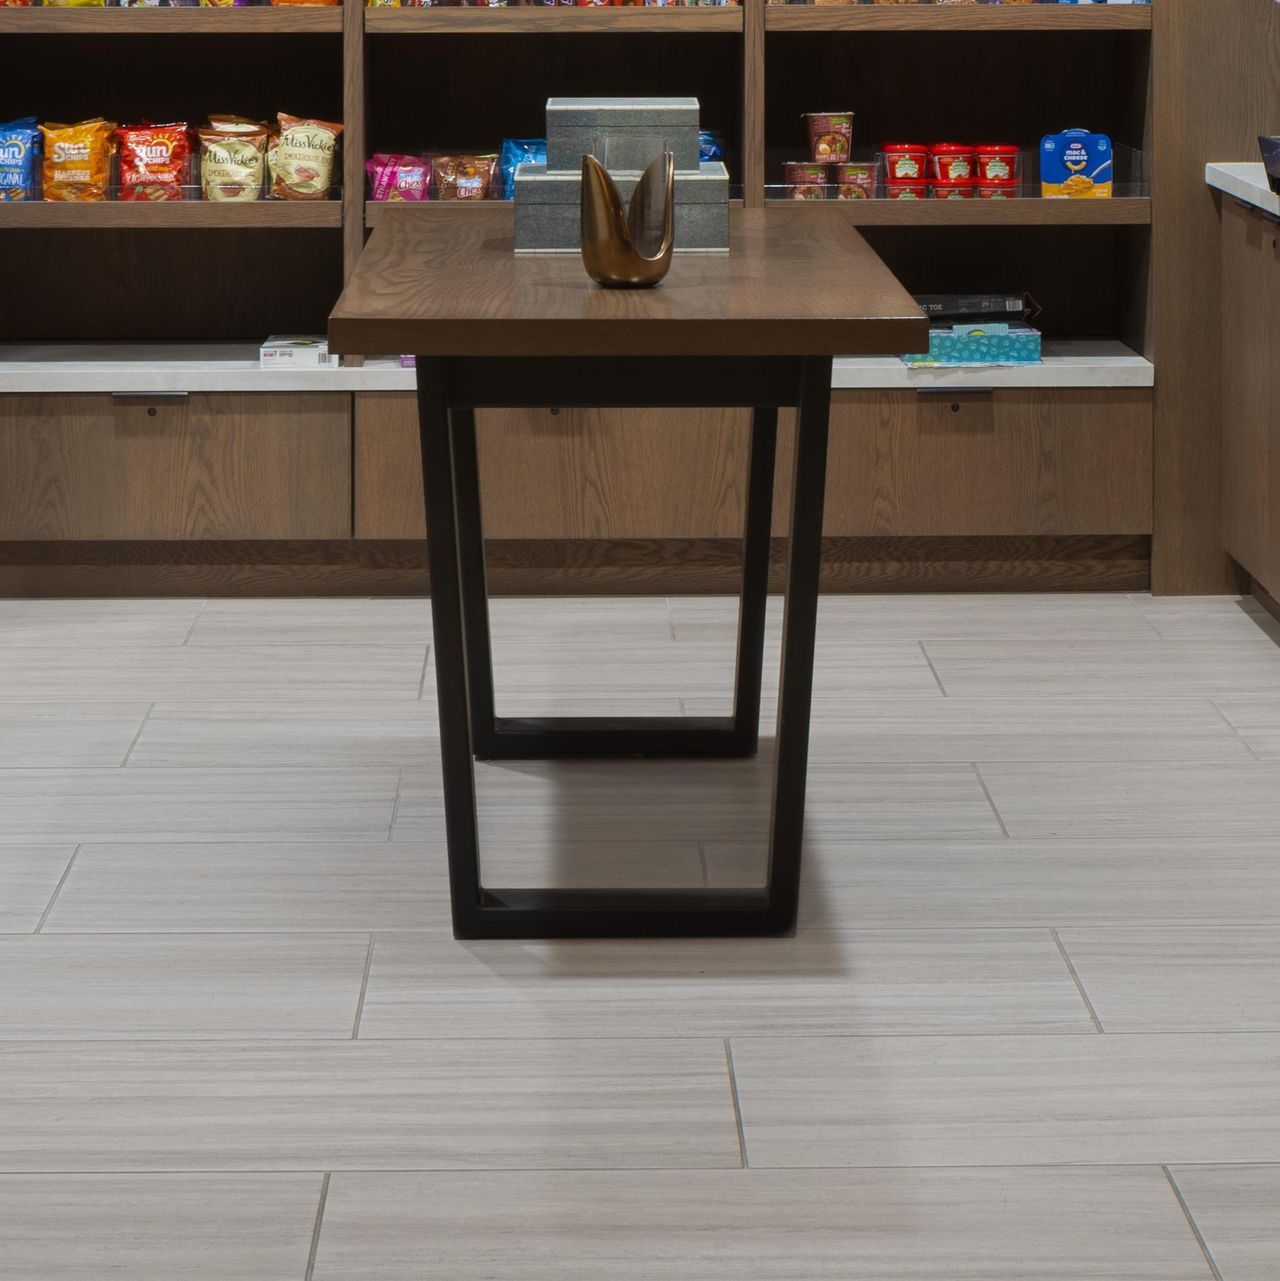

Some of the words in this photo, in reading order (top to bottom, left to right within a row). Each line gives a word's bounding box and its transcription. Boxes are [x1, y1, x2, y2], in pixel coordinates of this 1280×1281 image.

[282, 134, 307, 148] Miss
[0, 158, 23, 166] CHIPS
[206, 150, 228, 165] Miss
[398, 179, 422, 191] Chex
[457, 187, 481, 198] Chex
